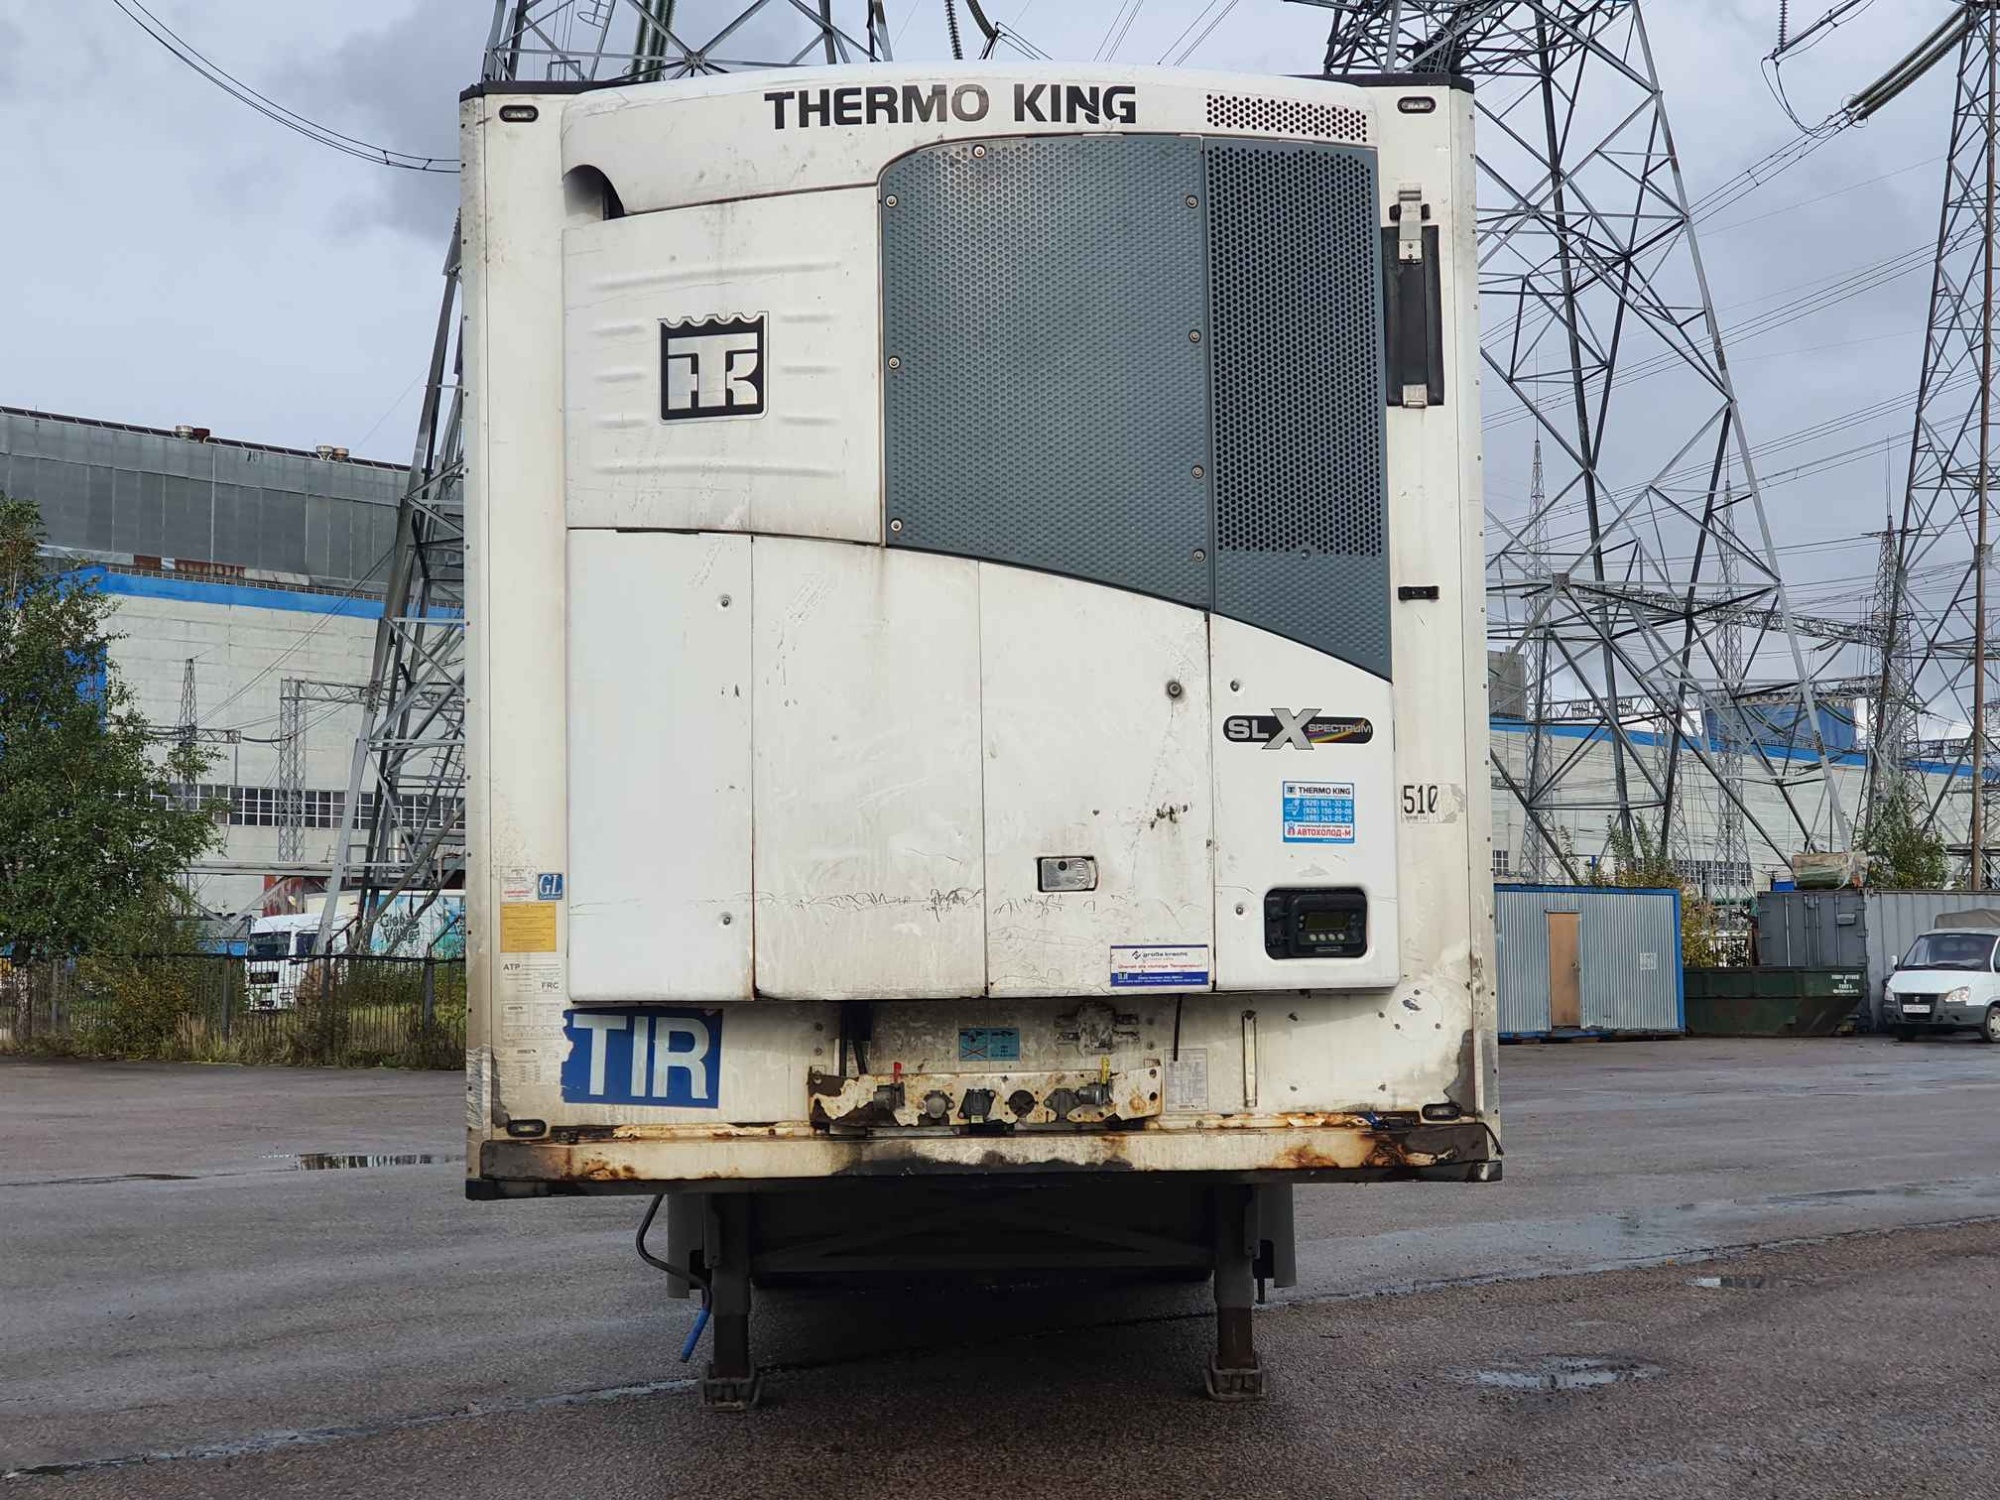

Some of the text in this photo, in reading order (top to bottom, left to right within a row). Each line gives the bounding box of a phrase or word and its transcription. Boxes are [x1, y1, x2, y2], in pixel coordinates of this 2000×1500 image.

[764, 83, 1136, 129] THERMO KING
[1308, 723, 1371, 734] SPECTRUM
[1297, 828, 1351, 837] АВТОХОЛОД-М
[539, 874, 561, 895] GL
[503, 963, 521, 971] ATP
[573, 1014, 709, 1100] TIR
